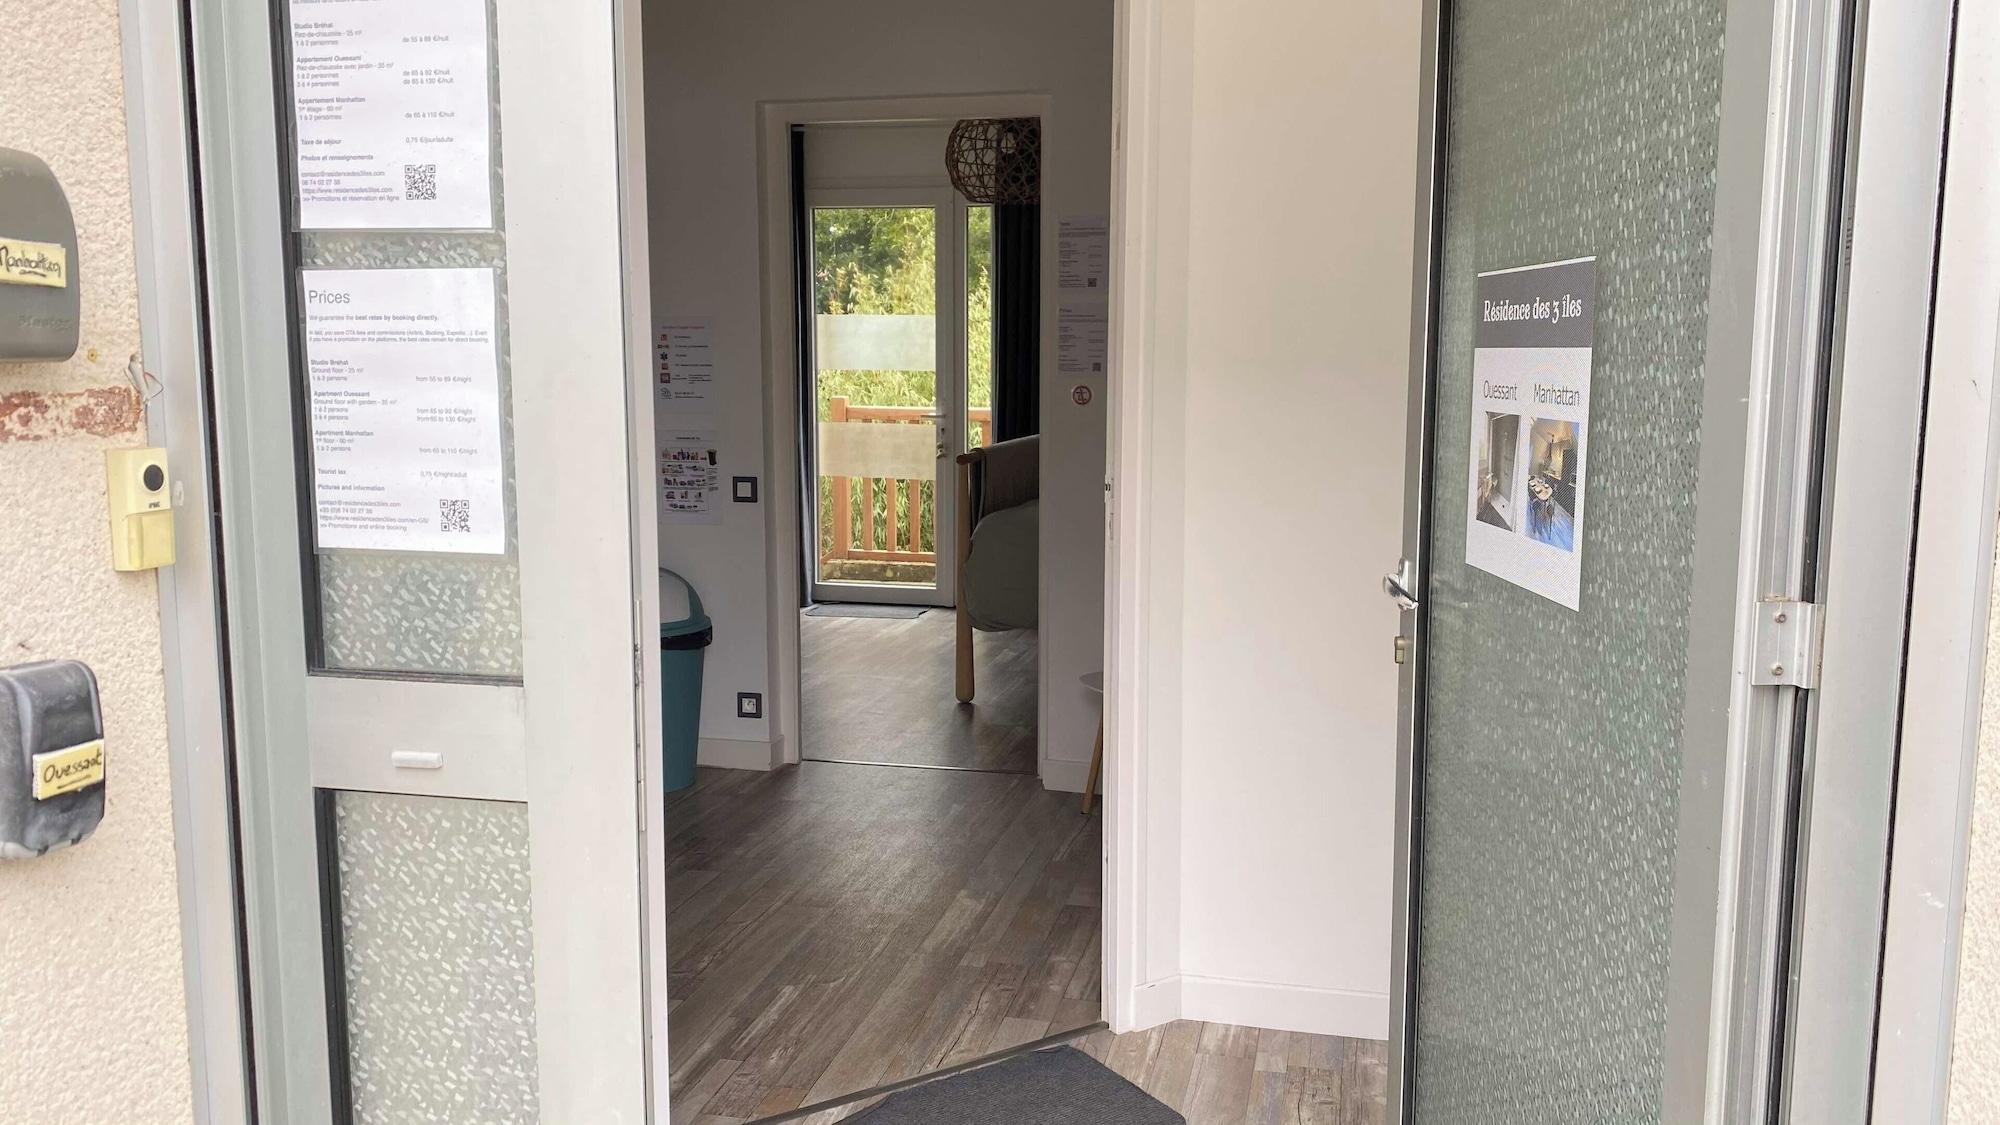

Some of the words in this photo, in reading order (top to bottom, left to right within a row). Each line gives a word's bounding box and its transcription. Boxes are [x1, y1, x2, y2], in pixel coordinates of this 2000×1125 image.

[309, 290, 350, 304] Prices
[1483, 298, 1531, 322] Résidence
[1532, 296, 1550, 320] des
[1551, 300, 1560, 324] 3
[383, 314, 391, 322] by
[392, 314, 415, 322] booking
[1483, 380, 1518, 401] Ouessant
[1533, 383, 1581, 407] Manhattan
[43, 747, 103, 784] Ouessant
